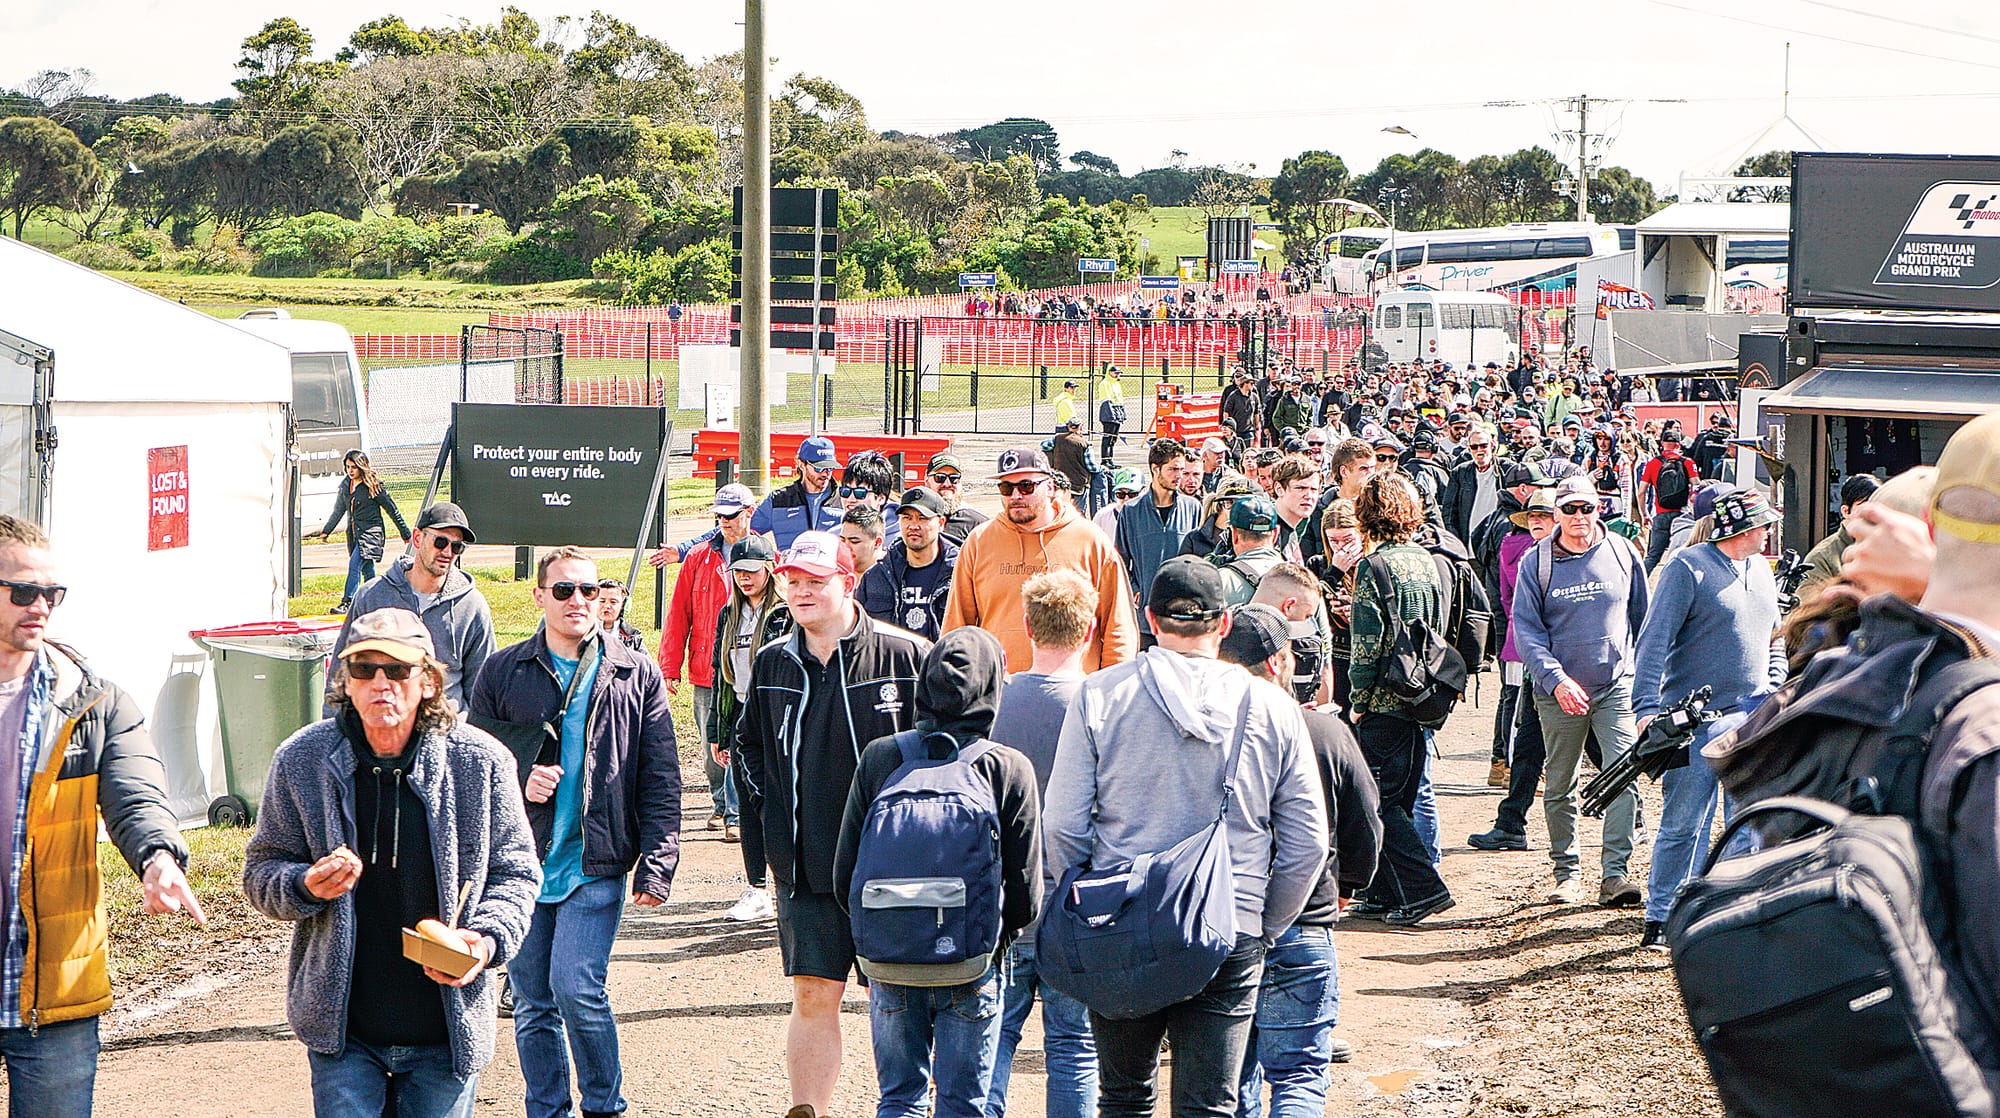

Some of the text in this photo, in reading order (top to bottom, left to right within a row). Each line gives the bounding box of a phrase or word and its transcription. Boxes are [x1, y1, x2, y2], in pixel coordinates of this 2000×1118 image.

[1903, 242, 1975, 255] AUSTRALIAN
[1085, 260, 1110, 270] Rhyll
[1224, 262, 1237, 271] San
[1897, 253, 1974, 267] MOTORCYCLE
[1439, 265, 1494, 280] Driver
[1891, 264, 1961, 278] GRAND PRIX
[1599, 288, 1650, 309] MILLER
[473, 444, 642, 465] Protect your entire body
[510, 464, 605, 481] on every ride.
[152, 471, 187, 493] LOST &
[152, 494, 186, 516] FOUND
[542, 491, 572, 506] TAC
